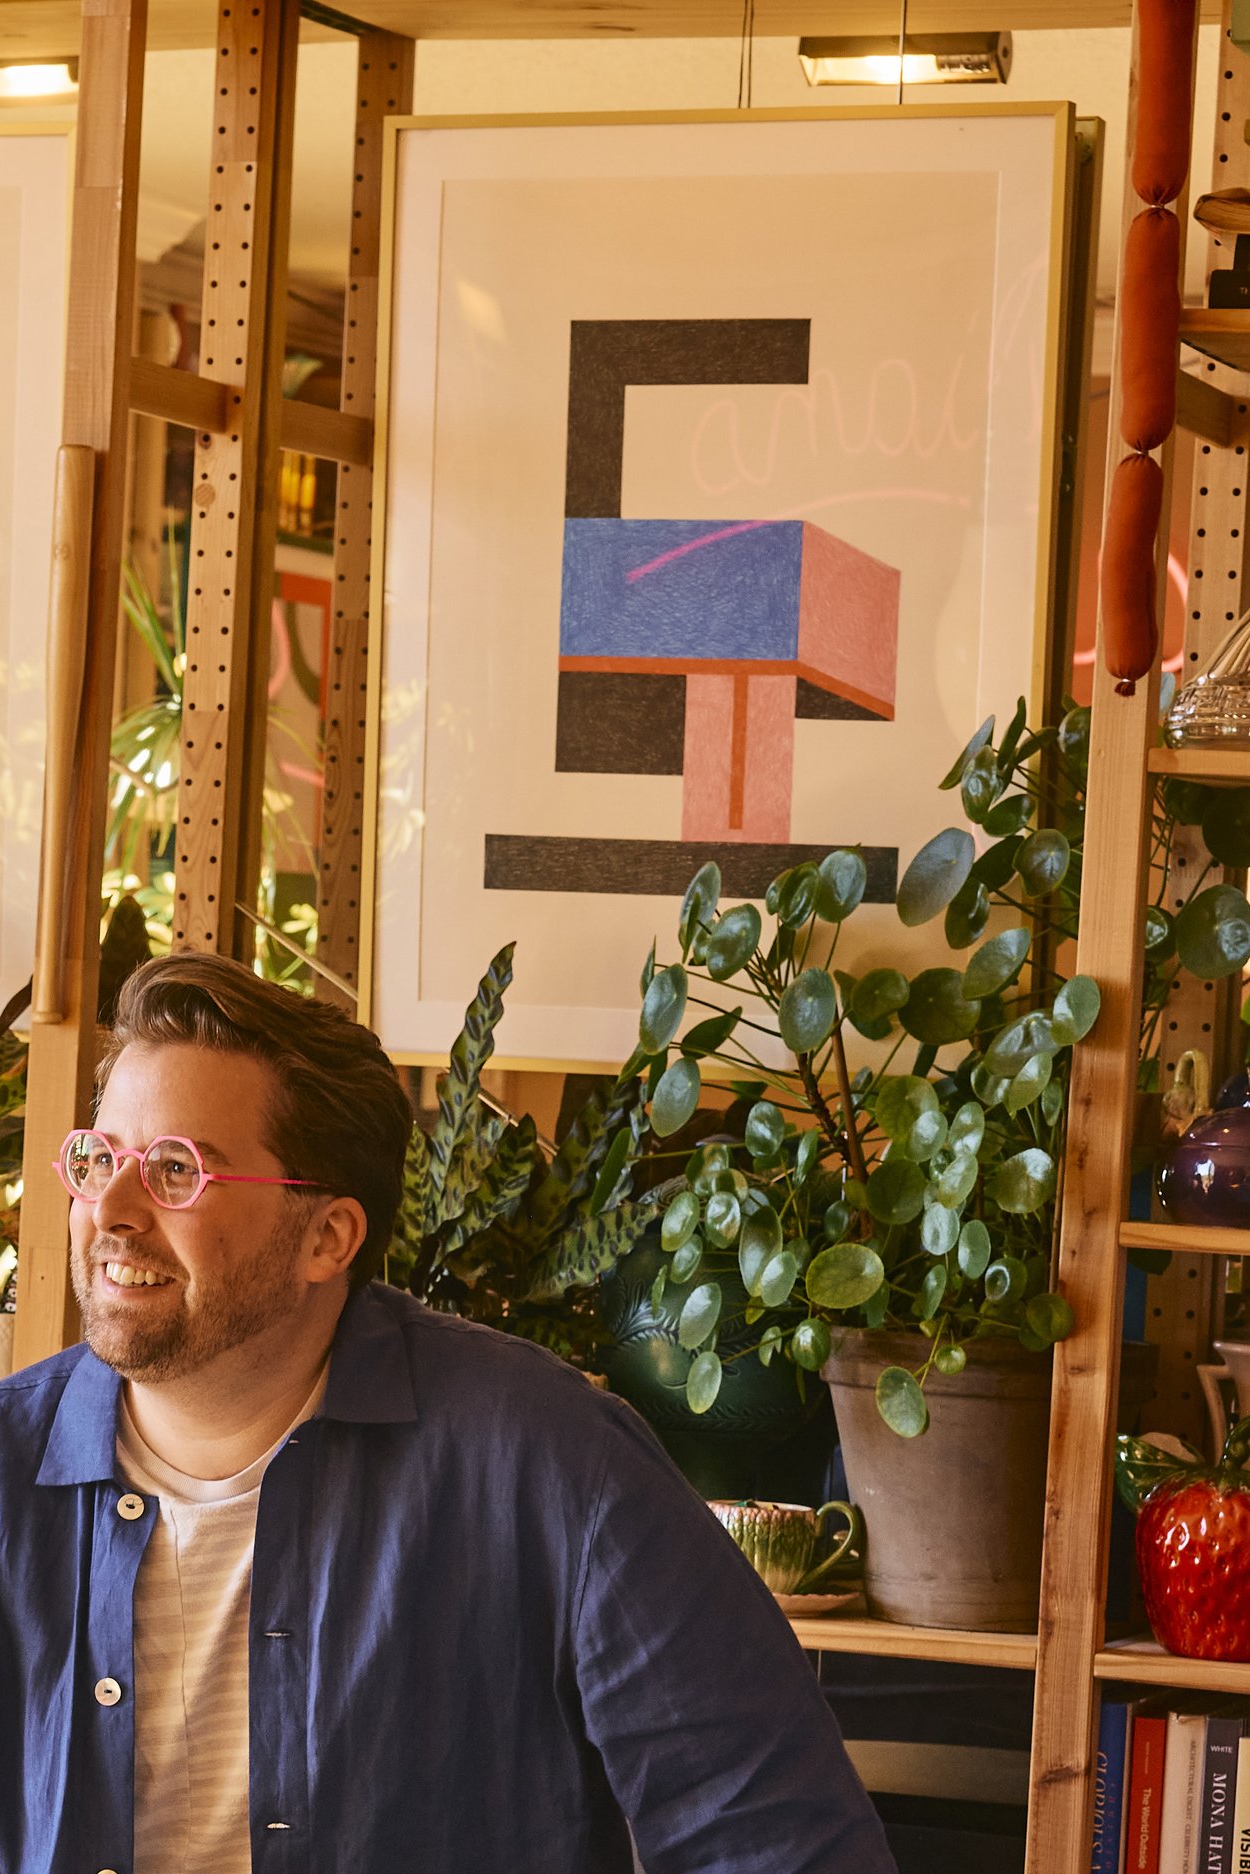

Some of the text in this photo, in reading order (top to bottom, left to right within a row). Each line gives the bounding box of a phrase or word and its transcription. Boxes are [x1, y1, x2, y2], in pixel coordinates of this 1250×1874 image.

[1210, 1746, 1233, 1754] WHITE
[1138, 1787, 1152, 1870] The World Outside
[1210, 1772, 1227, 1829] MONA
